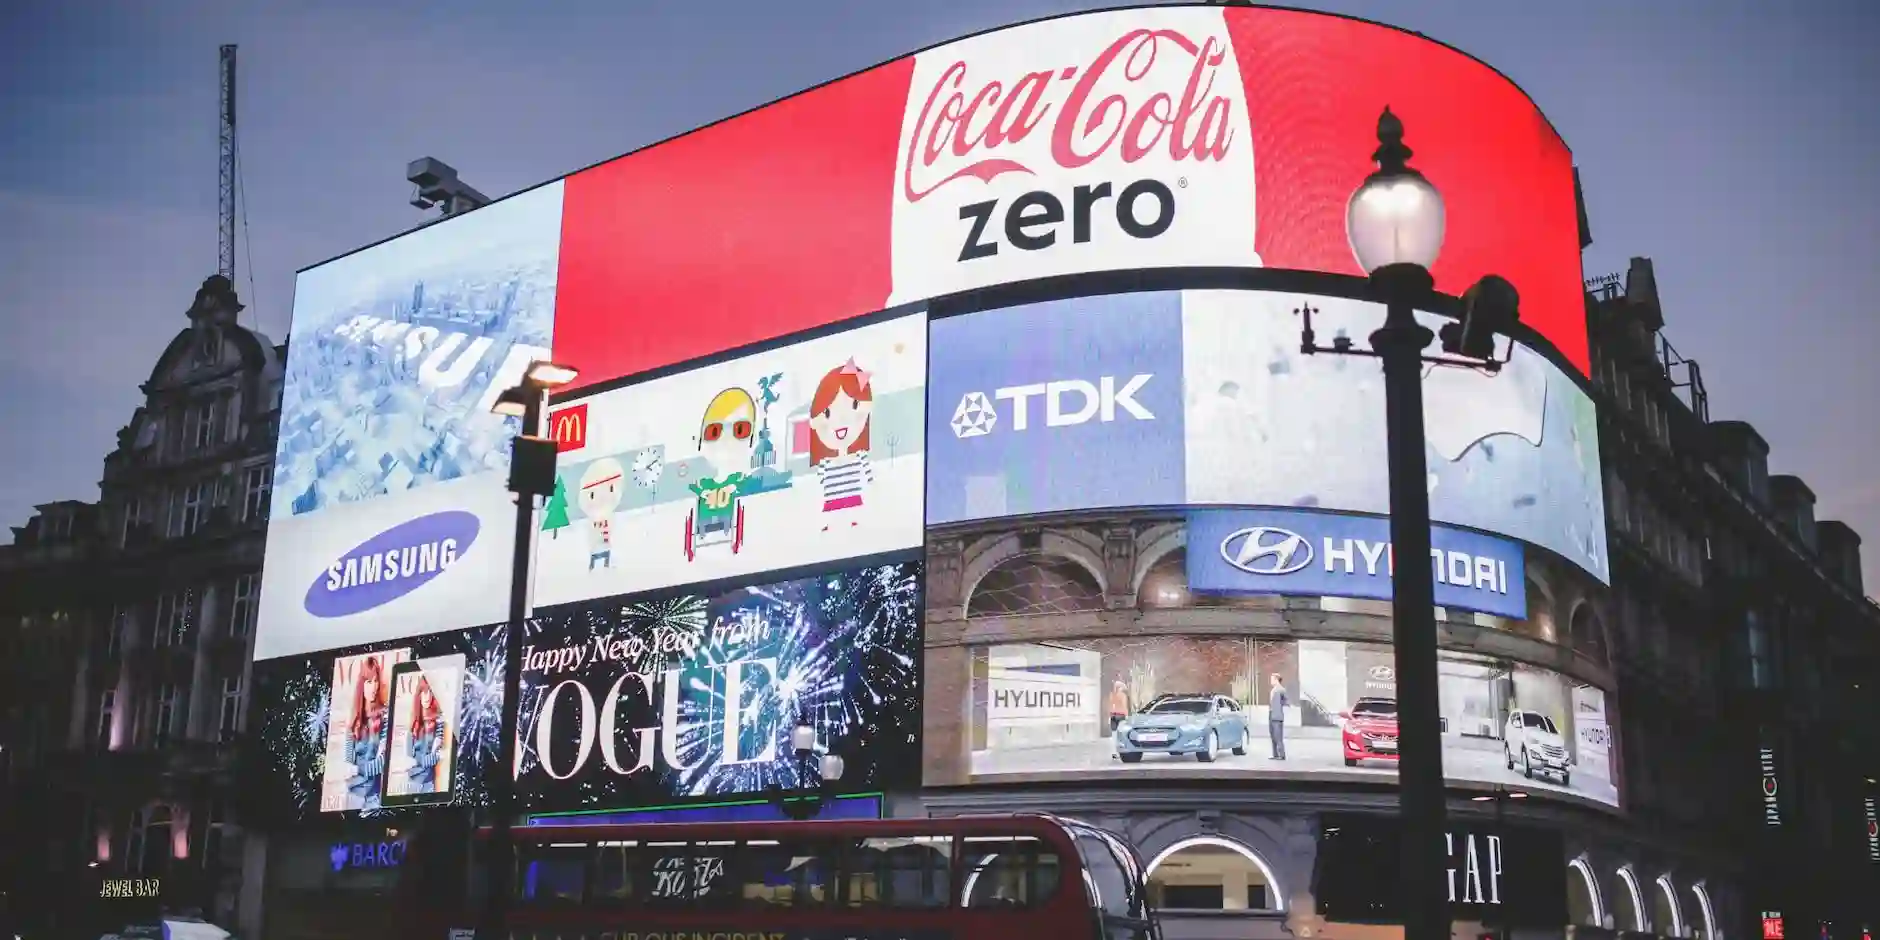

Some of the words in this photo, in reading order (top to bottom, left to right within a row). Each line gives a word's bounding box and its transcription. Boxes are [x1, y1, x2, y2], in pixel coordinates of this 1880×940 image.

[905, 28, 1234, 203] Coca-Cola
[957, 178, 1175, 262] zero
[995, 374, 1156, 431] TDK
[326, 538, 457, 592] SAMSUNG
[1323, 537, 1506, 595] HYNDAI
[994, 688, 1081, 709] HYUNDAI
[352, 840, 408, 867] BARC
[100, 879, 133, 898] JEWEL
[136, 878, 160, 897] BAR
